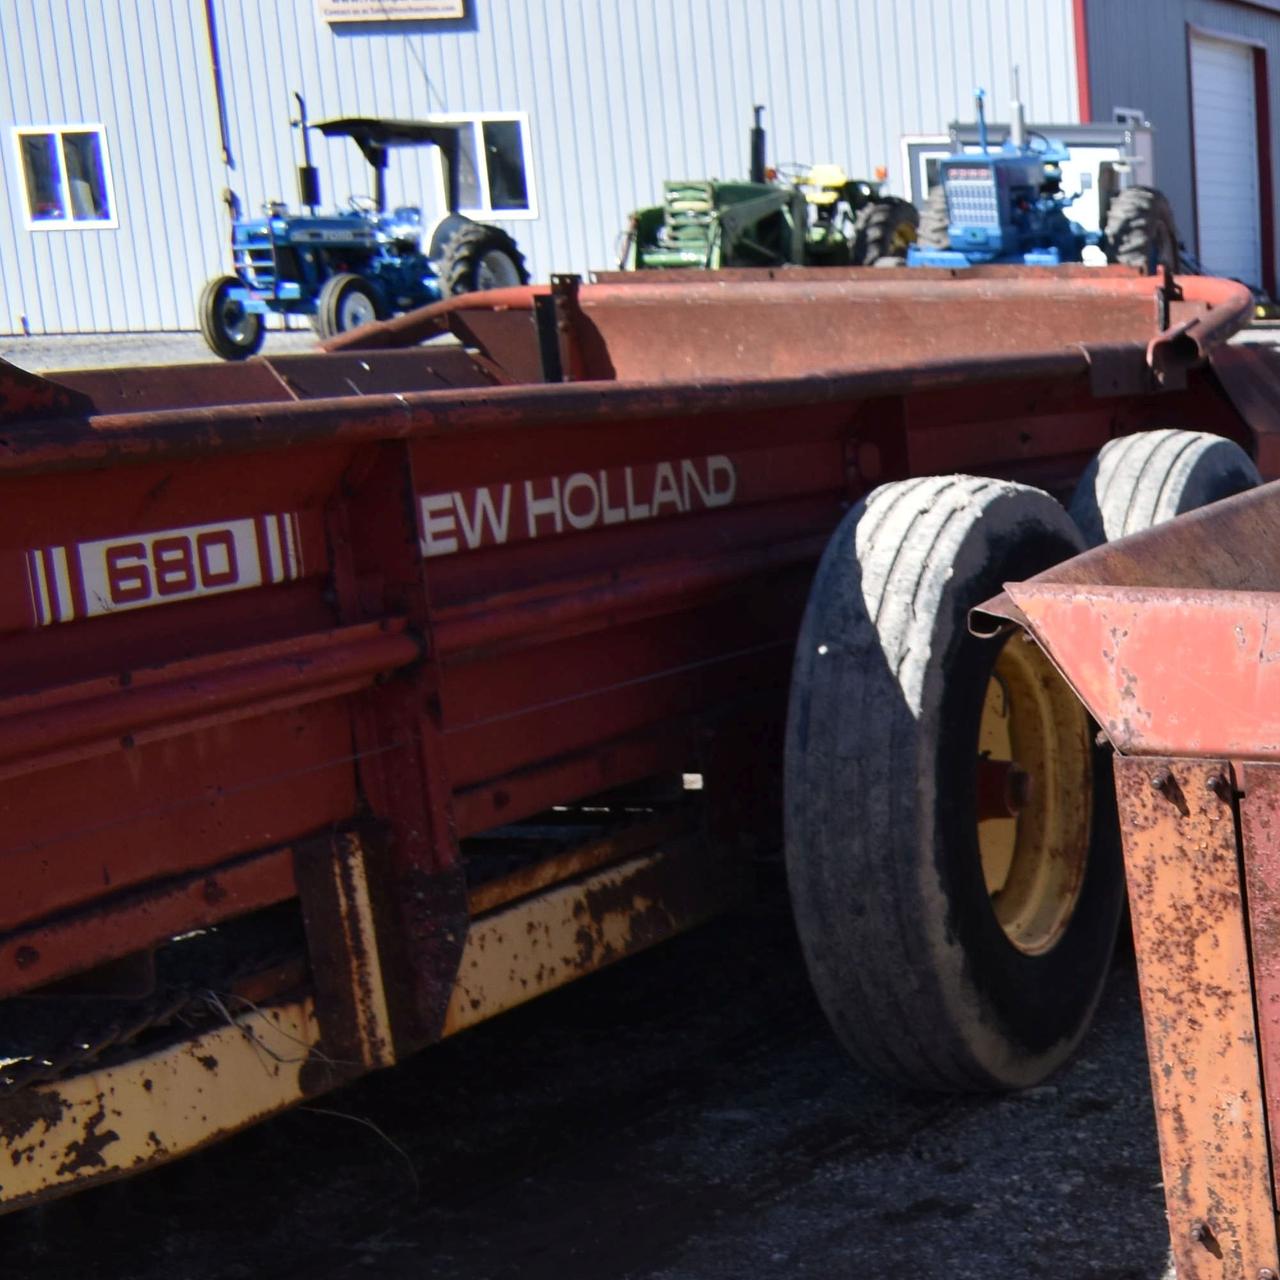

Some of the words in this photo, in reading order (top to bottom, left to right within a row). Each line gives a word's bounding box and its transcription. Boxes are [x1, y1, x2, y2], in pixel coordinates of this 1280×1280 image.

[419, 483, 512, 558] EW
[525, 454, 737, 539] HOLLAND
[105, 528, 240, 605] 680
